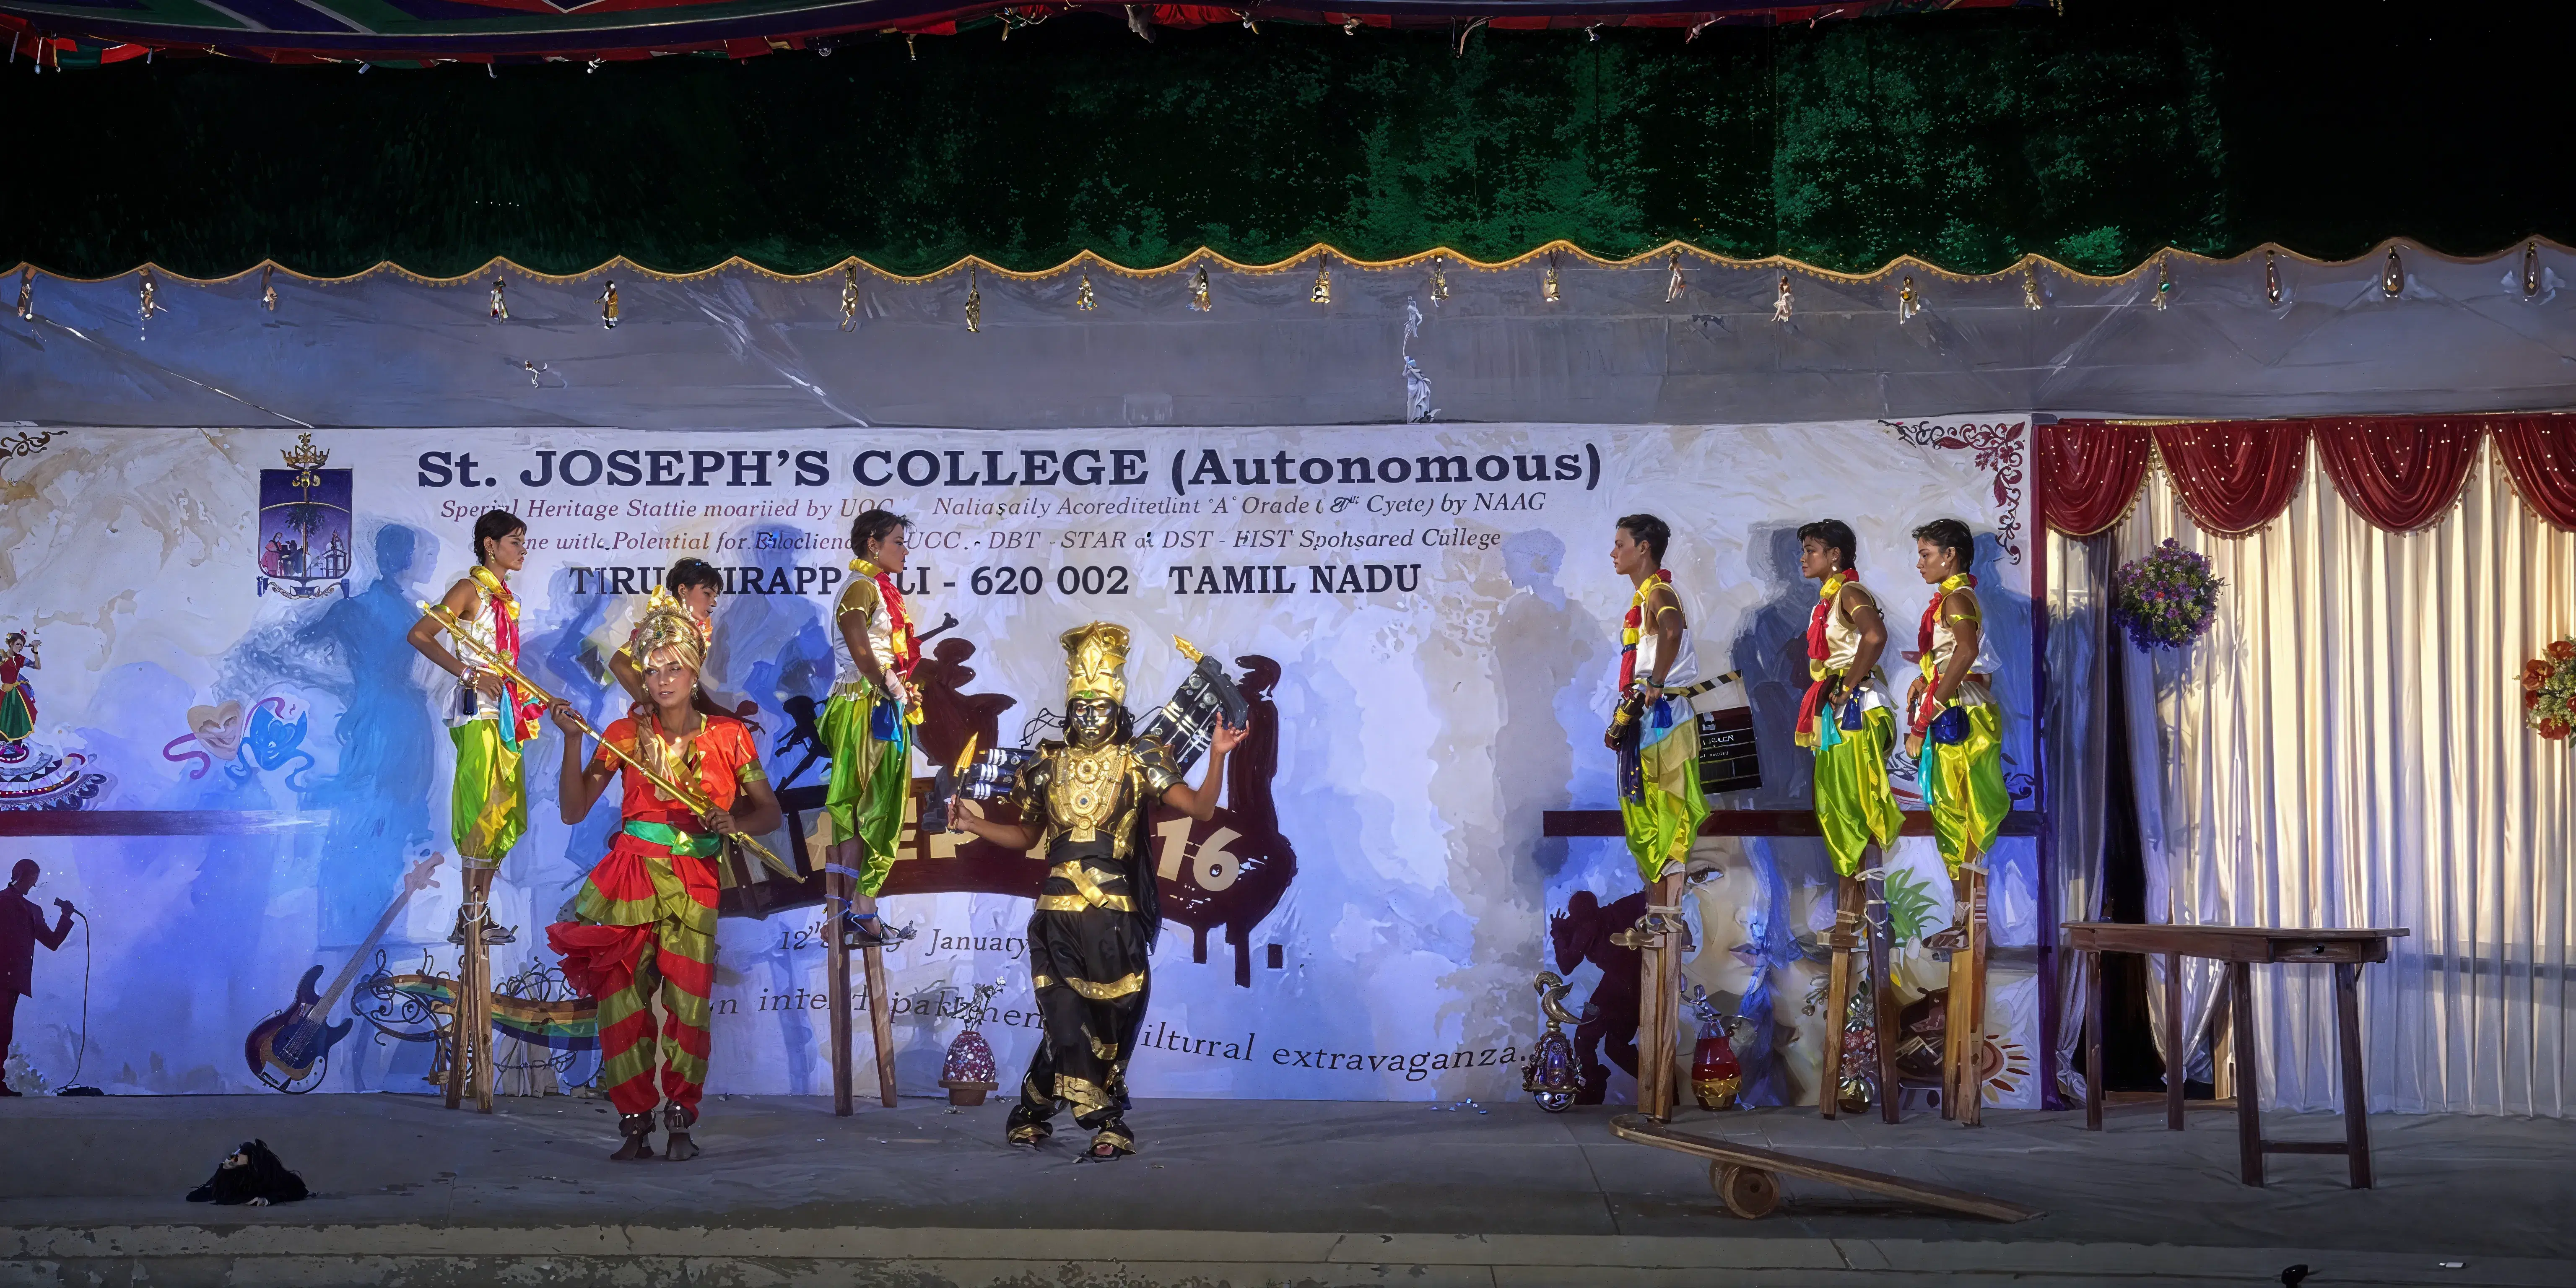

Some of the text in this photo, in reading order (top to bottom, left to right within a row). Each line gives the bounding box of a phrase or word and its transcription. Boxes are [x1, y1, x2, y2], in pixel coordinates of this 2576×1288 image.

[418, 451, 496, 487] St.
[852, 449, 1148, 487] COLLEGE
[1171, 443, 1600, 496] (Autonomous)
[527, 499, 618, 521] Heritage
[807, 499, 832, 520] by
[1441, 493, 1467, 515] by
[1473, 492, 1546, 511] NAAG
[988, 531, 1041, 549] DBT
[1060, 530, 1127, 549] STAR
[1162, 530, 1214, 548] DST
[971, 566, 1044, 595] 620
[1057, 565, 1129, 595] 002
[1169, 565, 1296, 595] TAMIL
[1309, 564, 1421, 594] NADU
[925, 928, 1028, 960] January
[1272, 1046, 1527, 1082] extravaganza.
